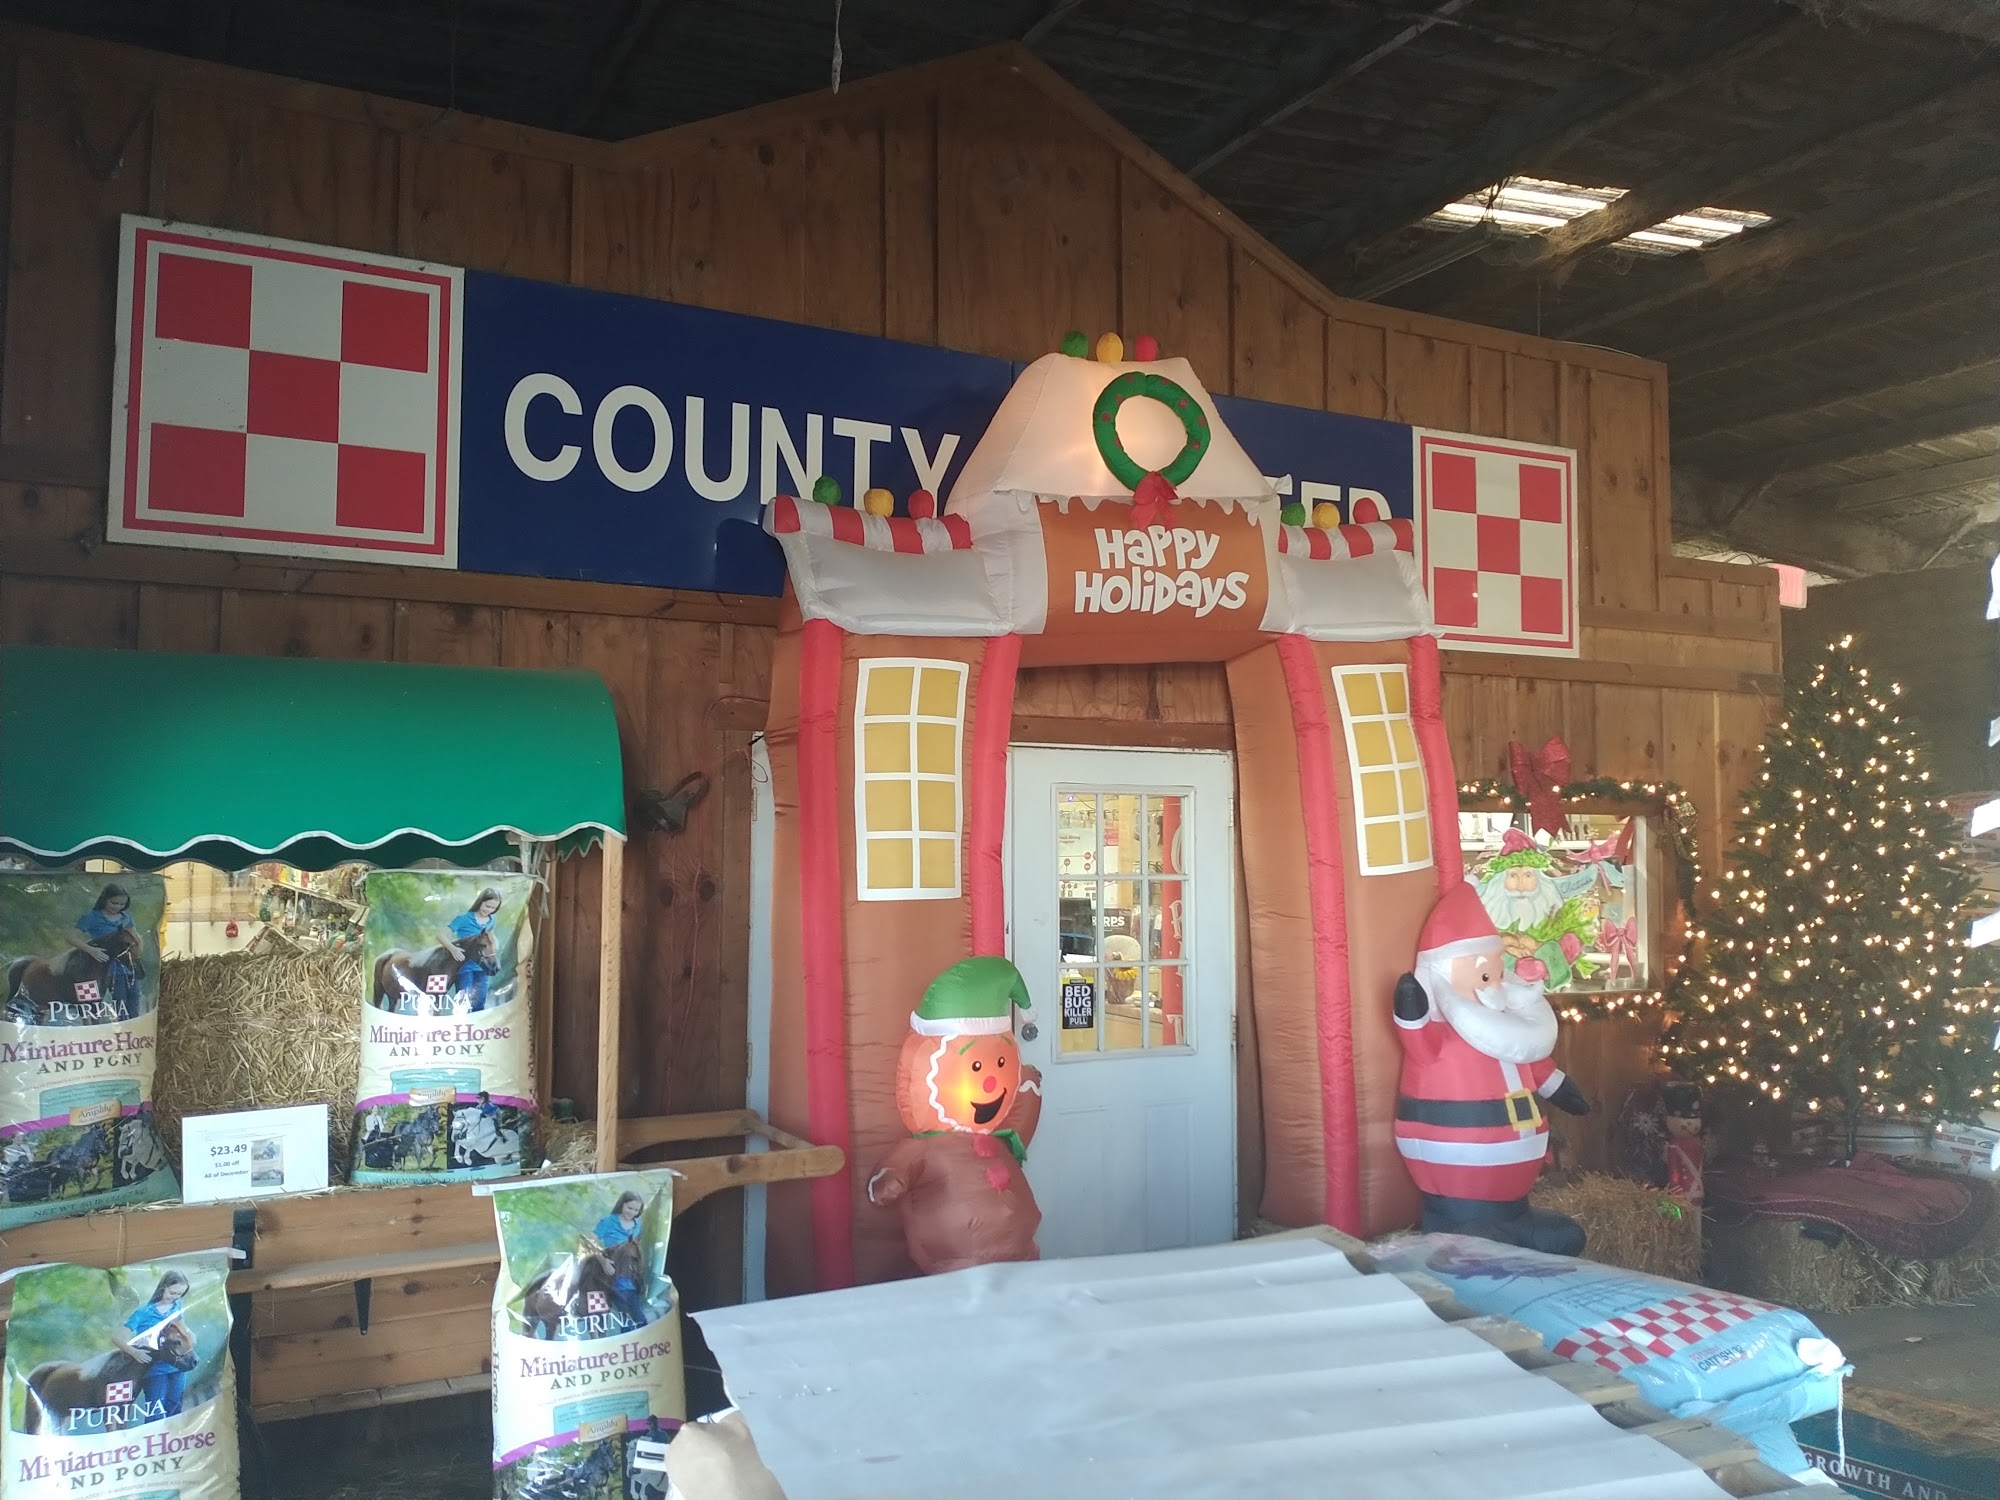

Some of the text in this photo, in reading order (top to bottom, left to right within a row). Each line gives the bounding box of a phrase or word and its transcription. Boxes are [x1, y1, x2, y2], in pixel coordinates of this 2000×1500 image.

[504, 372, 961, 518] COUNTY
[1064, 996, 1092, 1008] BUG
[1065, 985, 1091, 997] BED
[48, 999, 130, 1022] PURINA
[1064, 1007, 1092, 1017] KILLER
[454, 1023, 511, 1042] Horse
[1, 1039, 112, 1063] Miniature
[432, 1044, 485, 1056] PONY
[37, 1053, 142, 1074] AND PONY
[210, 1143, 247, 1157] $23.49
[558, 1312, 637, 1337] PURINA
[519, 1341, 671, 1378] Miniature Horse
[550, 1361, 651, 1390] AND PONY
[68, 1398, 167, 1431] PURINA
[144, 1431, 216, 1458] Horse
[70, 1456, 184, 1489] ND PONY
[1804, 1452, 1948, 1500] GROWTH AND
